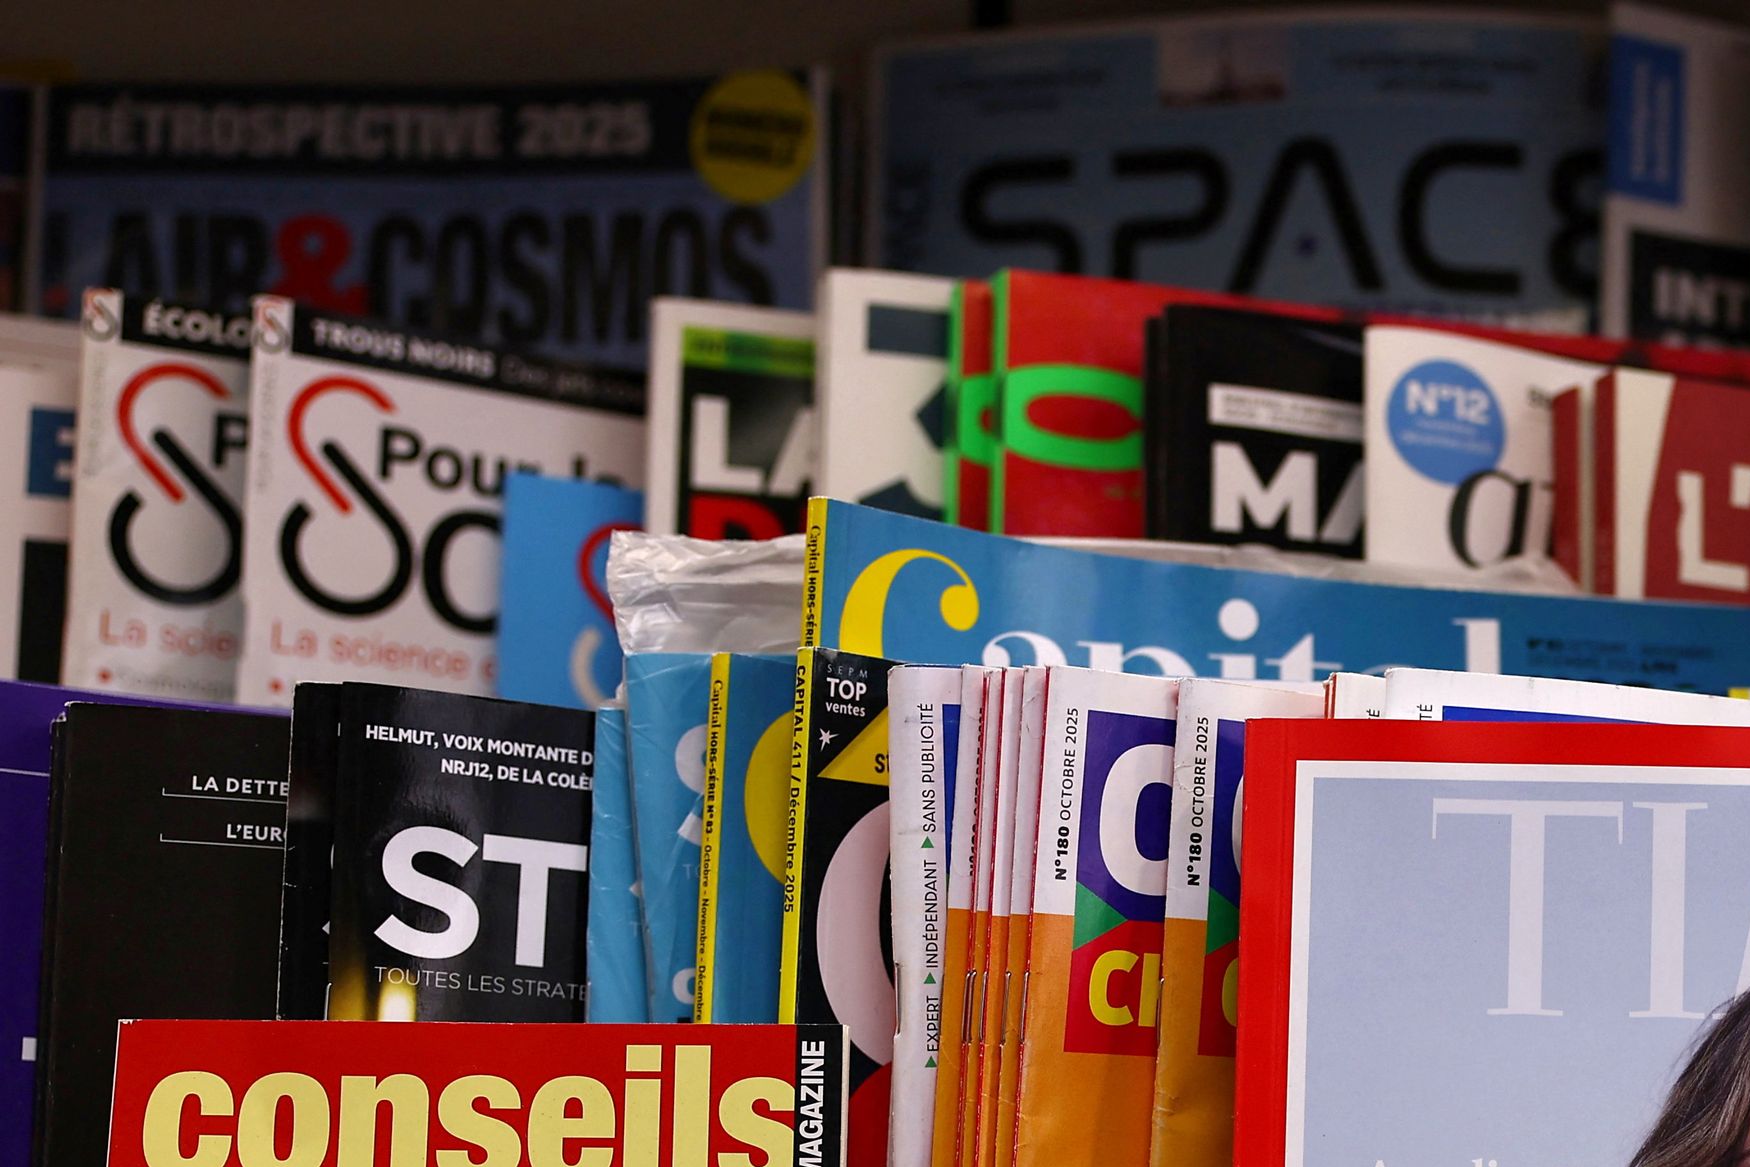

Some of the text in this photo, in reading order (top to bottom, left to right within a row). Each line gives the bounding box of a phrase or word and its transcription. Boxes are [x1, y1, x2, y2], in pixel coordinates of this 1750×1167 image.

[516, 102, 651, 159] 2025
[313, 318, 496, 379] TROUS NOIRS
[825, 677, 868, 702] TOP
[825, 701, 867, 718] ventes
[365, 724, 579, 765] HELMUT, VOIX MONTANTE
[192, 775, 289, 797] LA DETTE
[440, 758, 494, 783] NRJ12,
[784, 665, 807, 913] CAPITAL Décembre 2025
[1055, 707, 1080, 881] N°180 OCTOBRE 2025
[1187, 716, 1210, 887] N°180 OCTOBRE 2025
[919, 703, 940, 1052] EXPERT INDÉPENDANT SANS PUBLICITÉ
[374, 966, 506, 994] TOUTES LES
